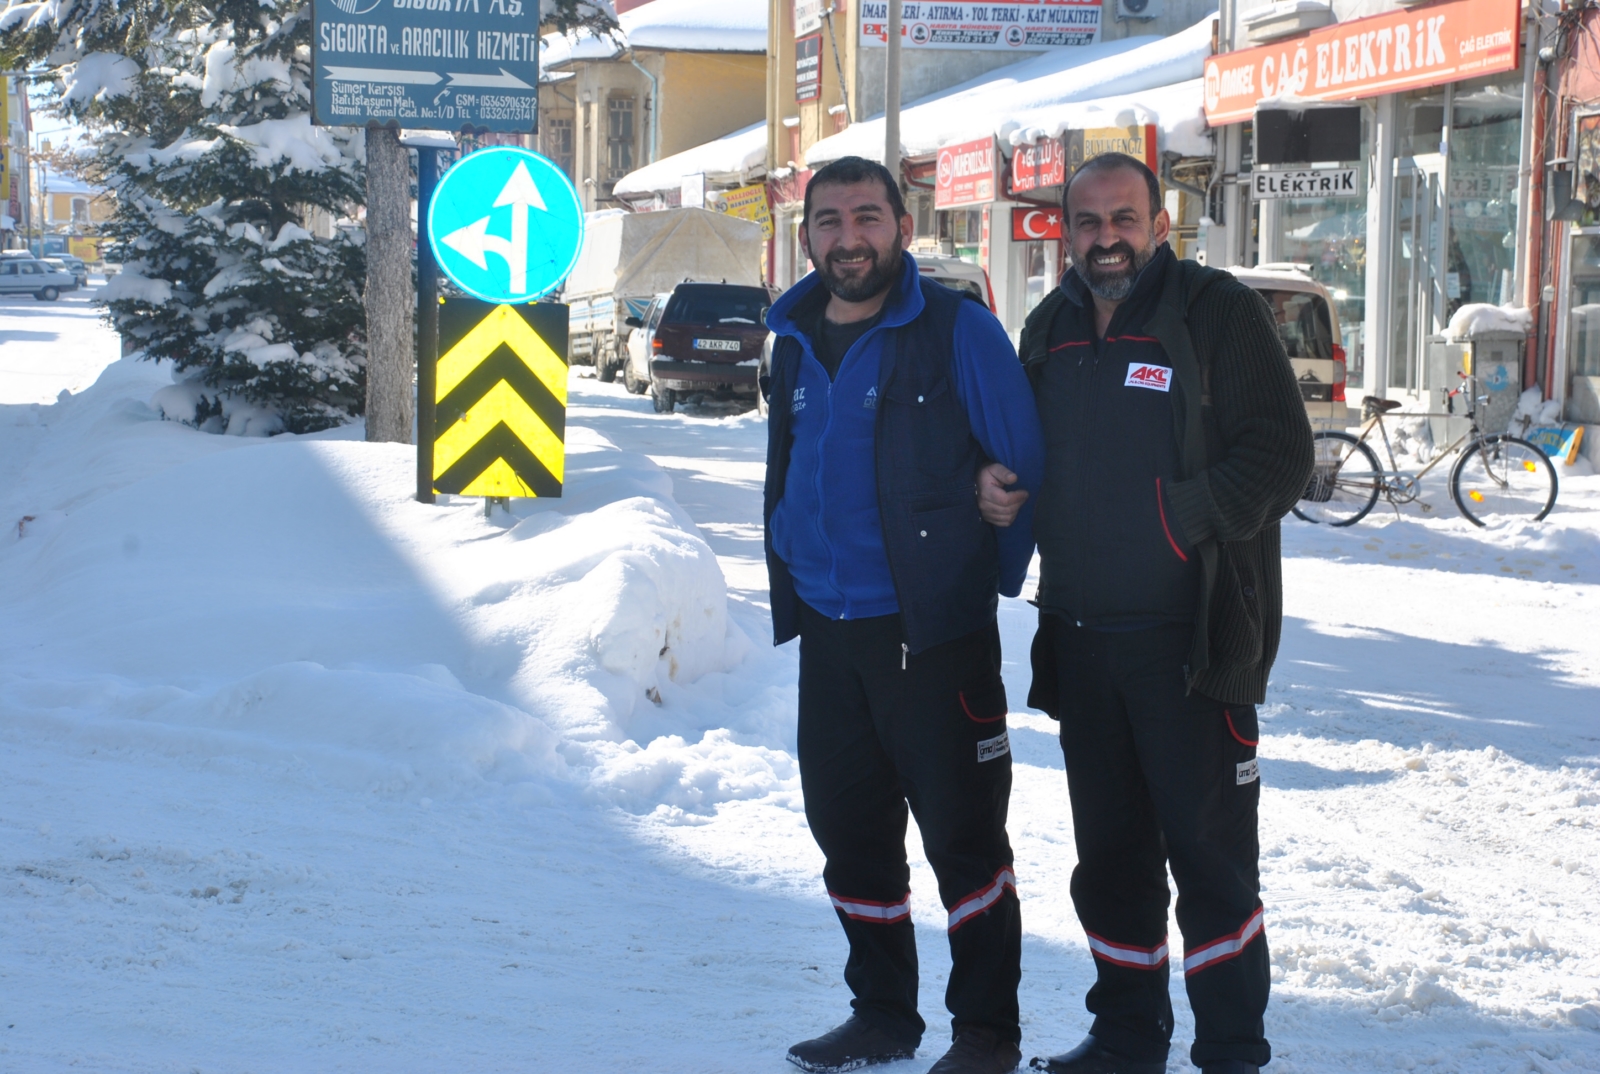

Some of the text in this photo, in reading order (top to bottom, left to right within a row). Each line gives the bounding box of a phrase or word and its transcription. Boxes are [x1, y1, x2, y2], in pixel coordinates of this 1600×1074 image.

[927, 6, 964, 20] AYIRMA
[972, 7, 988, 21] YOL
[1026, 8, 1046, 22] KAT
[390, 44, 400, 54] VE
[402, 26, 470, 58] ARACILIK
[331, 80, 366, 94] Sümer
[330, 104, 362, 116] Namık
[366, 105, 396, 117] Kemal
[698, 340, 707, 348] 42
[709, 341, 723, 349] AKR
[1130, 366, 1167, 382] AKL
